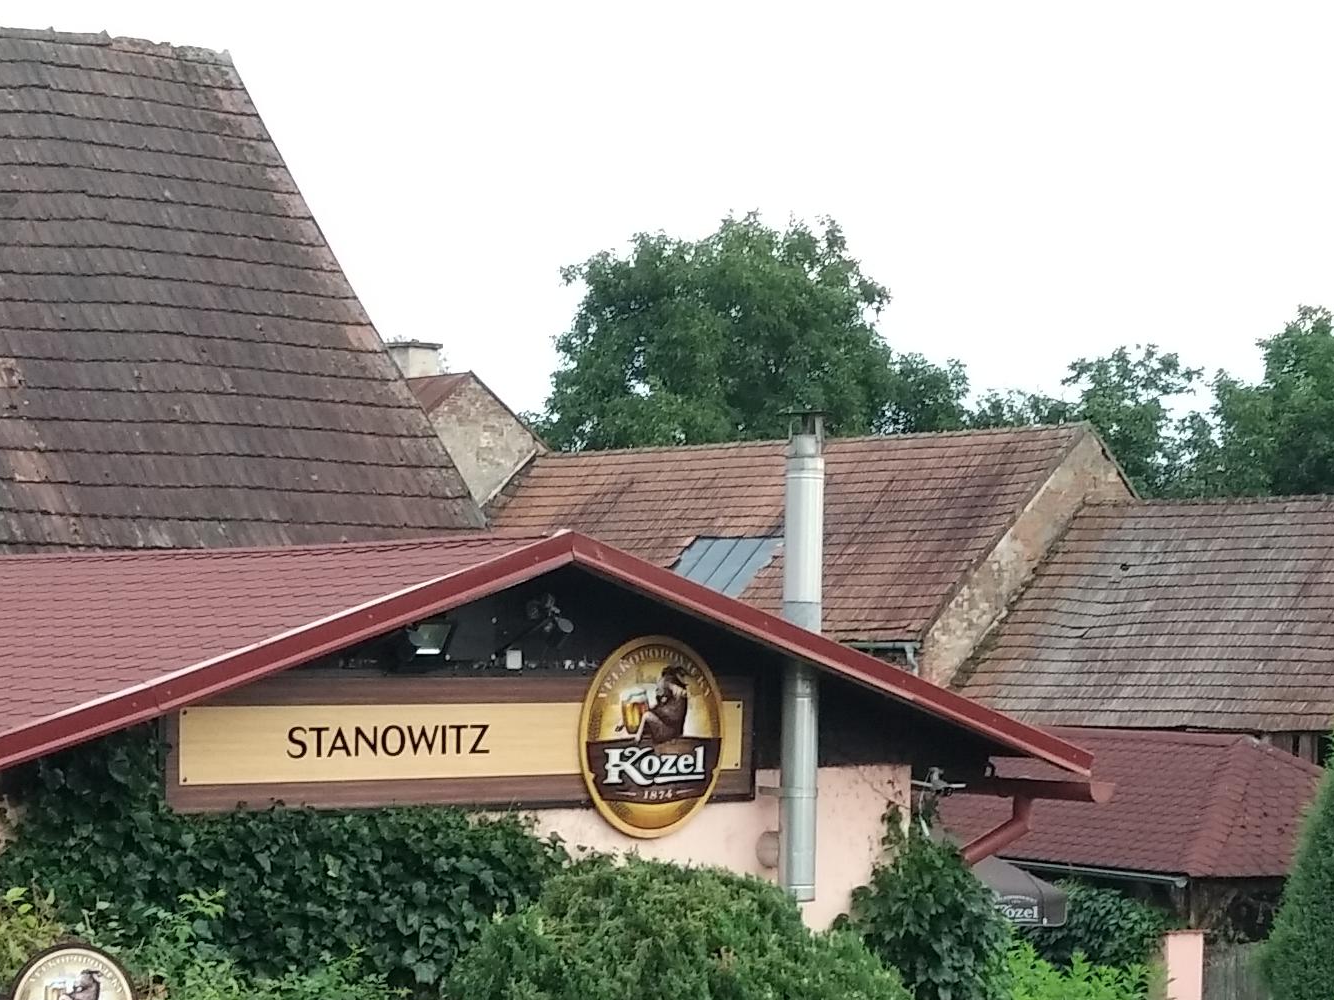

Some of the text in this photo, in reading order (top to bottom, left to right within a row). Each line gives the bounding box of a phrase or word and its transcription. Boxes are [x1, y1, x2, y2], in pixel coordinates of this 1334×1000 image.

[286, 724, 491, 759] STANOWITZ
[602, 745, 706, 786] Kozel
[642, 789, 673, 800] 1874
